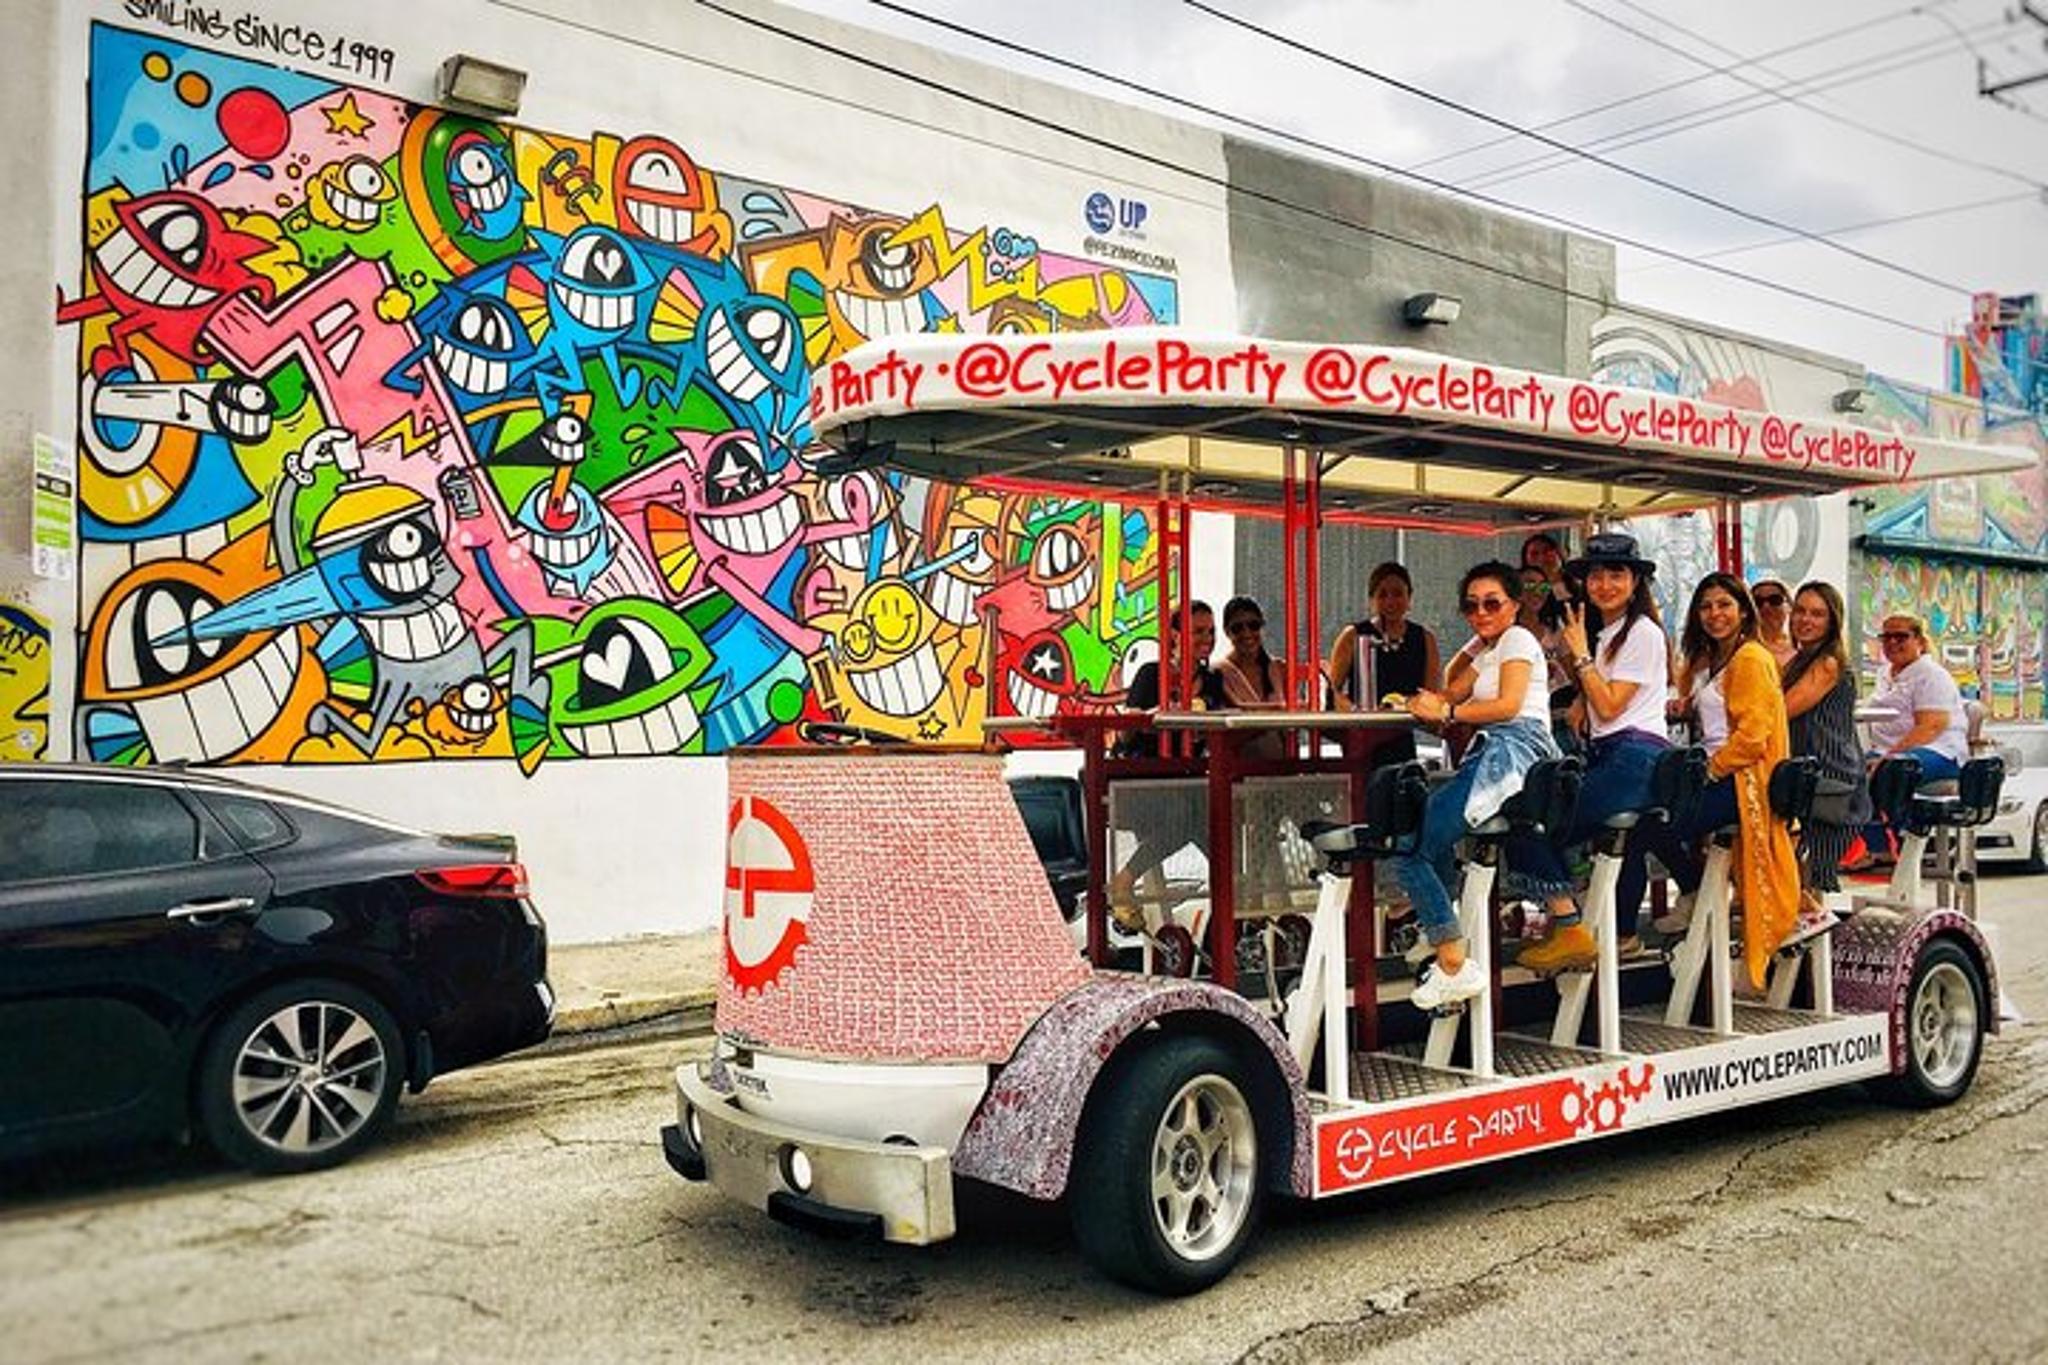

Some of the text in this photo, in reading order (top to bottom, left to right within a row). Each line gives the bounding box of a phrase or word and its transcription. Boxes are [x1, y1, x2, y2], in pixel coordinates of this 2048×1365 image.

[328, 37, 395, 83] 1999
[1119, 198, 1147, 229] UP
[954, 340, 1286, 403] @CycleParty
[1304, 348, 1554, 431] @CycleParty
[1568, 384, 1750, 459] @CycleParty
[1759, 416, 1916, 478] @CycleParty
[1663, 1032, 1882, 1101] WWW.CYCLEPARTY.COM
[1377, 1102, 1542, 1161] CYCLE PARTY
